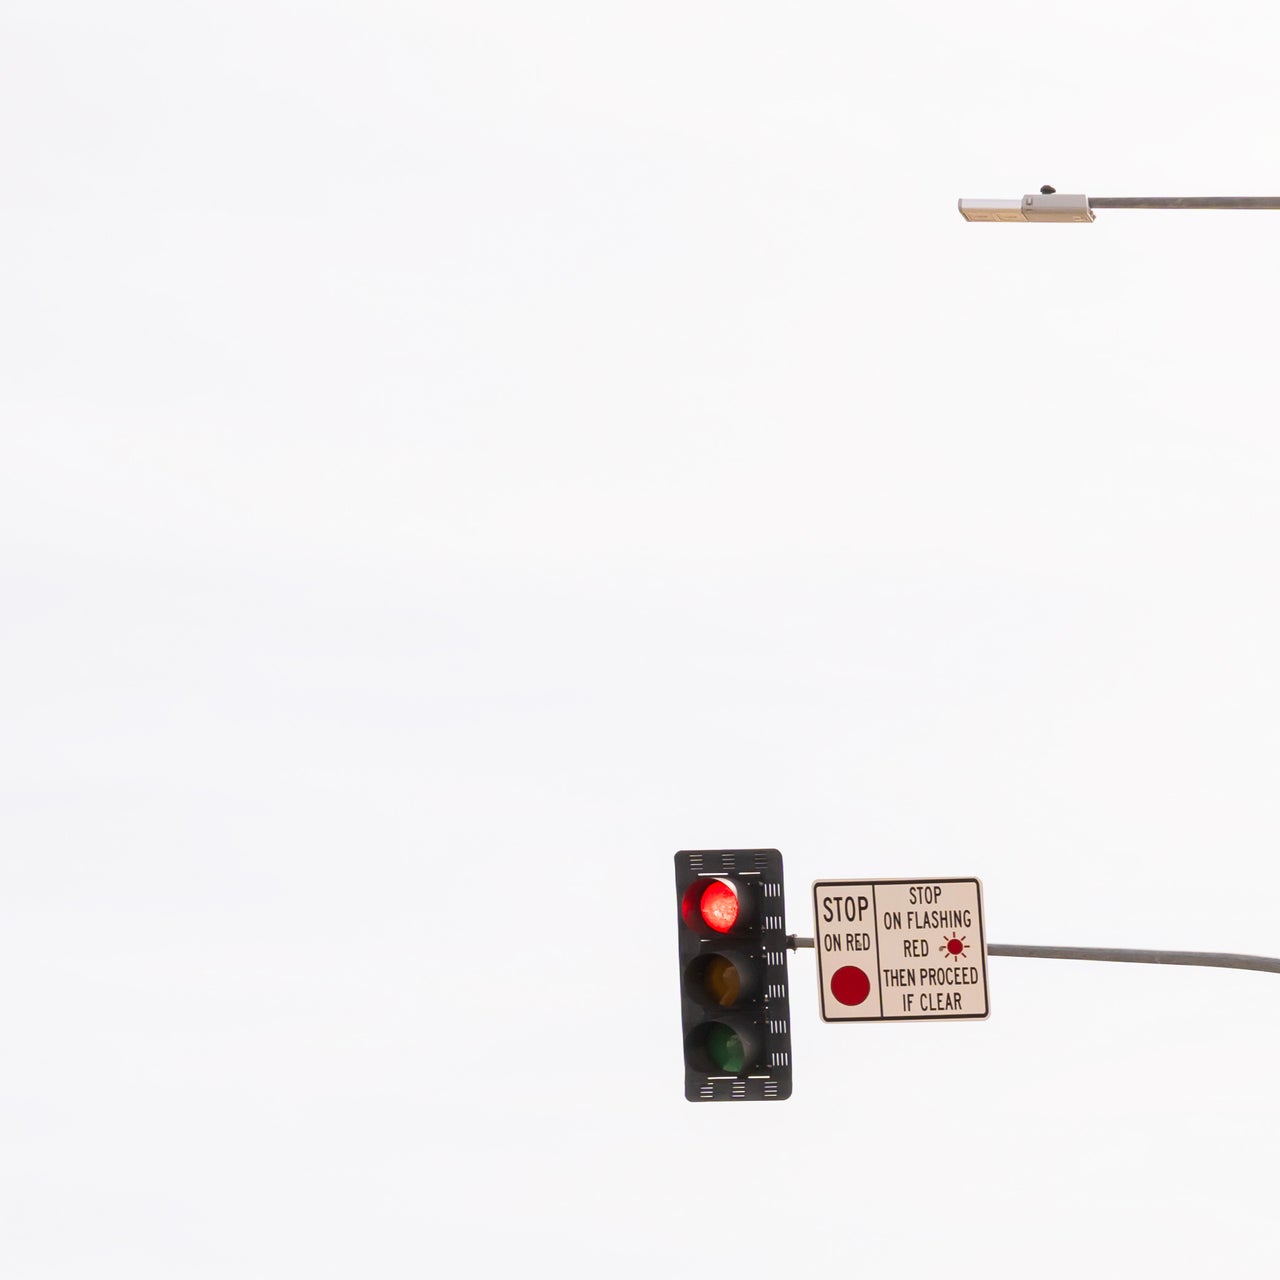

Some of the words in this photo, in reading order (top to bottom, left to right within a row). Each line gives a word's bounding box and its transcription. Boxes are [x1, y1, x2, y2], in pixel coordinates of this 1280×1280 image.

[909, 887, 942, 905] STOP
[822, 896, 869, 923] STOP
[883, 912, 901, 930] ON
[907, 910, 972, 929] FLASHING
[824, 933, 841, 952] ON
[846, 933, 871, 952] RED
[904, 940, 929, 958] RED
[883, 969, 916, 987] THEN
[920, 966, 979, 986] PROCEED
[903, 994, 916, 1012] IF
[920, 993, 962, 1011] CLEAR
